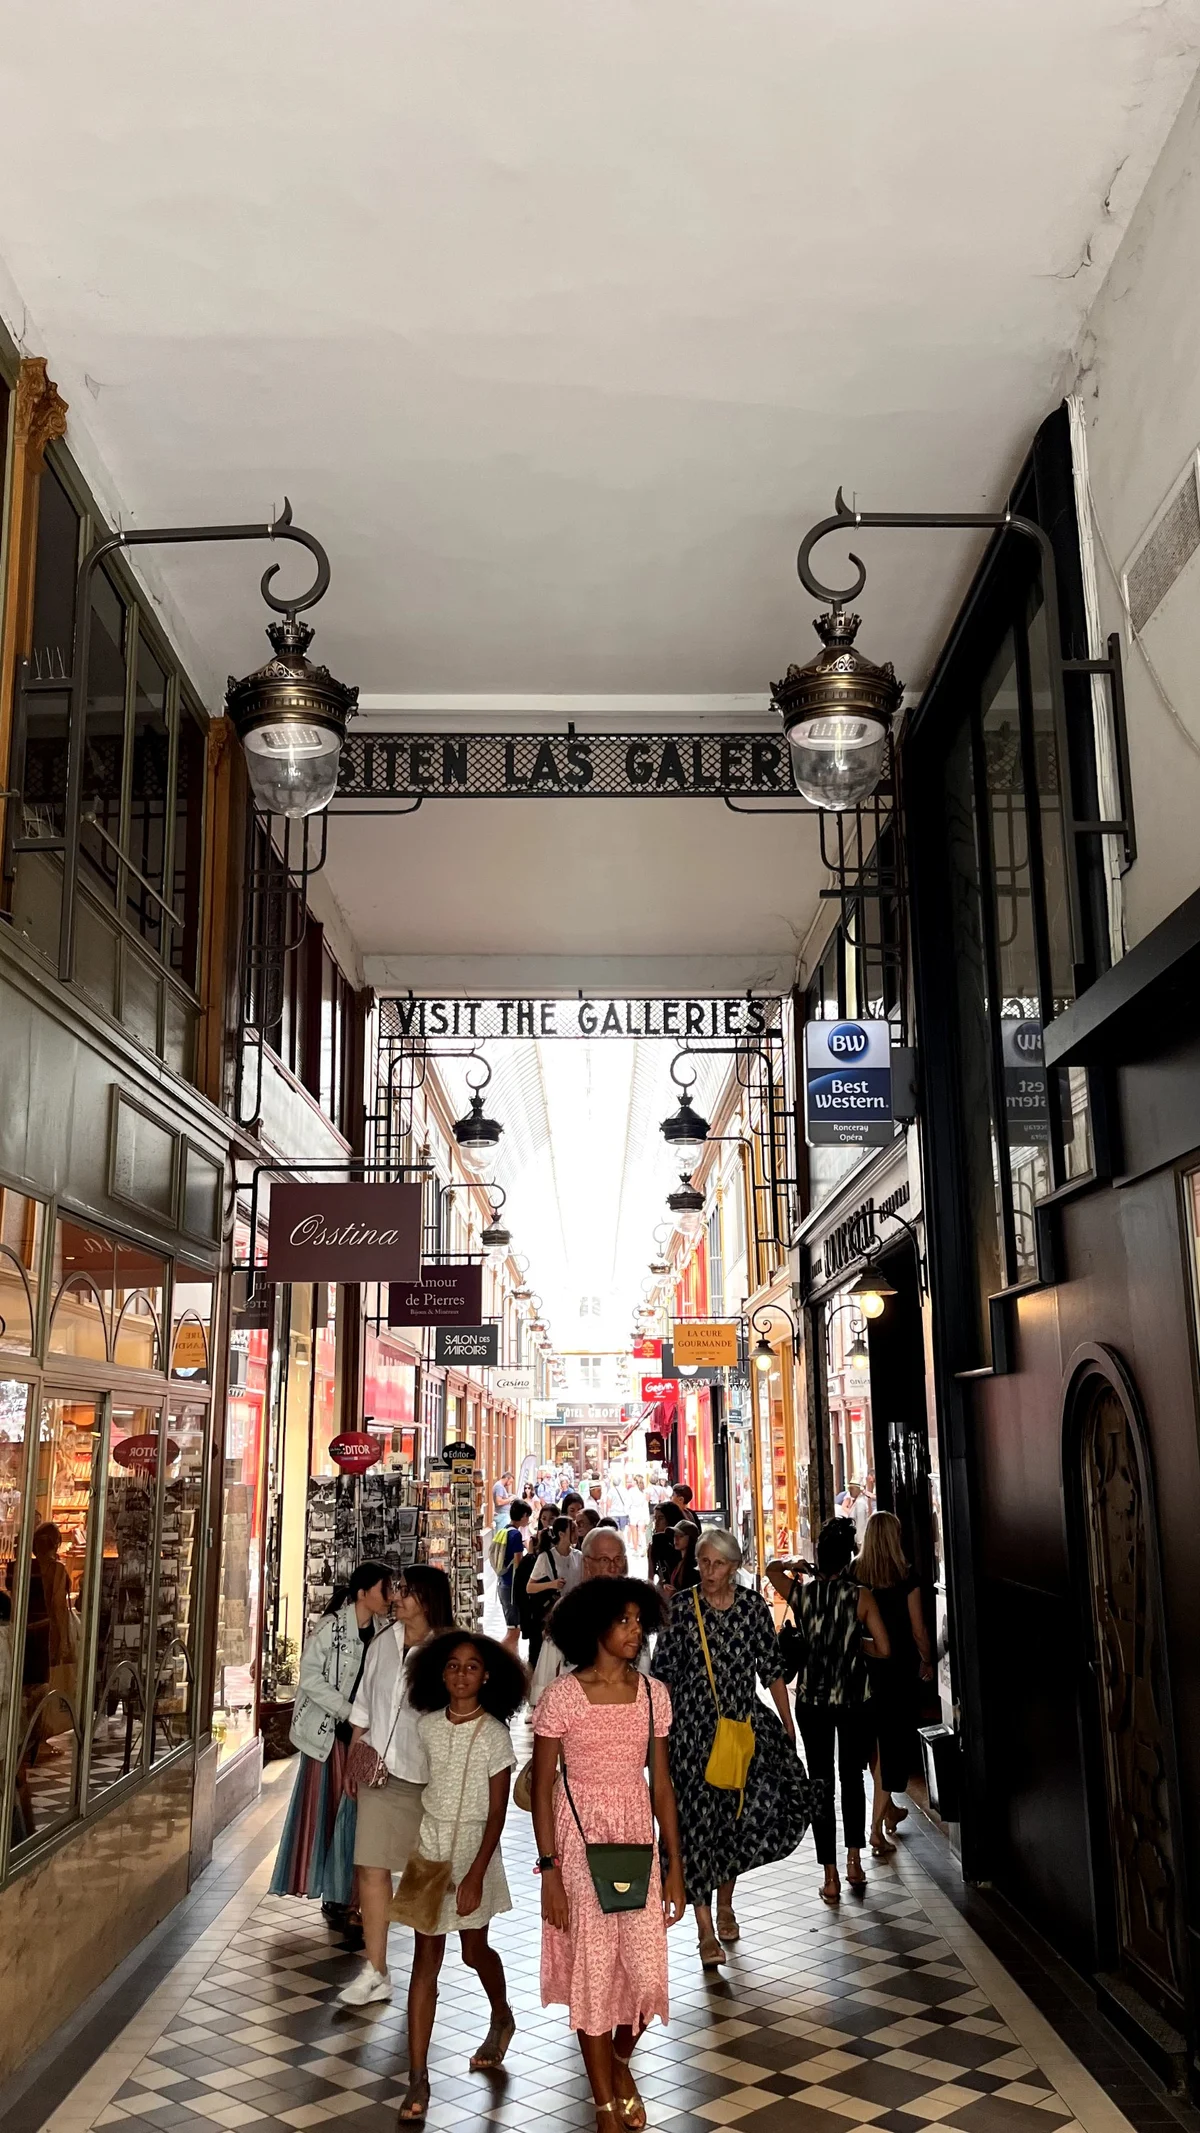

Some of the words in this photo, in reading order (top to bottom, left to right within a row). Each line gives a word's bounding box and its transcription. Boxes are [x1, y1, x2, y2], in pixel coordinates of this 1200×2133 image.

[338, 742, 467, 786] SITEN
[504, 742, 594, 786] LAS
[625, 742, 783, 787] GALER
[396, 1001, 482, 1036] VISIT
[497, 1001, 558, 1036] THE
[578, 1001, 766, 1036] GALLERIES
[832, 1035, 865, 1052] BW
[831, 1079, 869, 1094] Best
[833, 1124, 869, 1133] Ronceray
[839, 1133, 863, 1142] Opéra
[289, 1214, 400, 1247] Osstina
[405, 1293, 420, 1306] de
[423, 1292, 465, 1306] Pierres
[444, 1334, 478, 1345] SALON
[478, 1335, 491, 1343] DES
[687, 1330, 698, 1338] LA
[700, 1330, 723, 1338] CURE
[443, 1345, 487, 1355] MIROIRS
[496, 1378, 530, 1389] Casino
[448, 1450, 470, 1458] Editor
